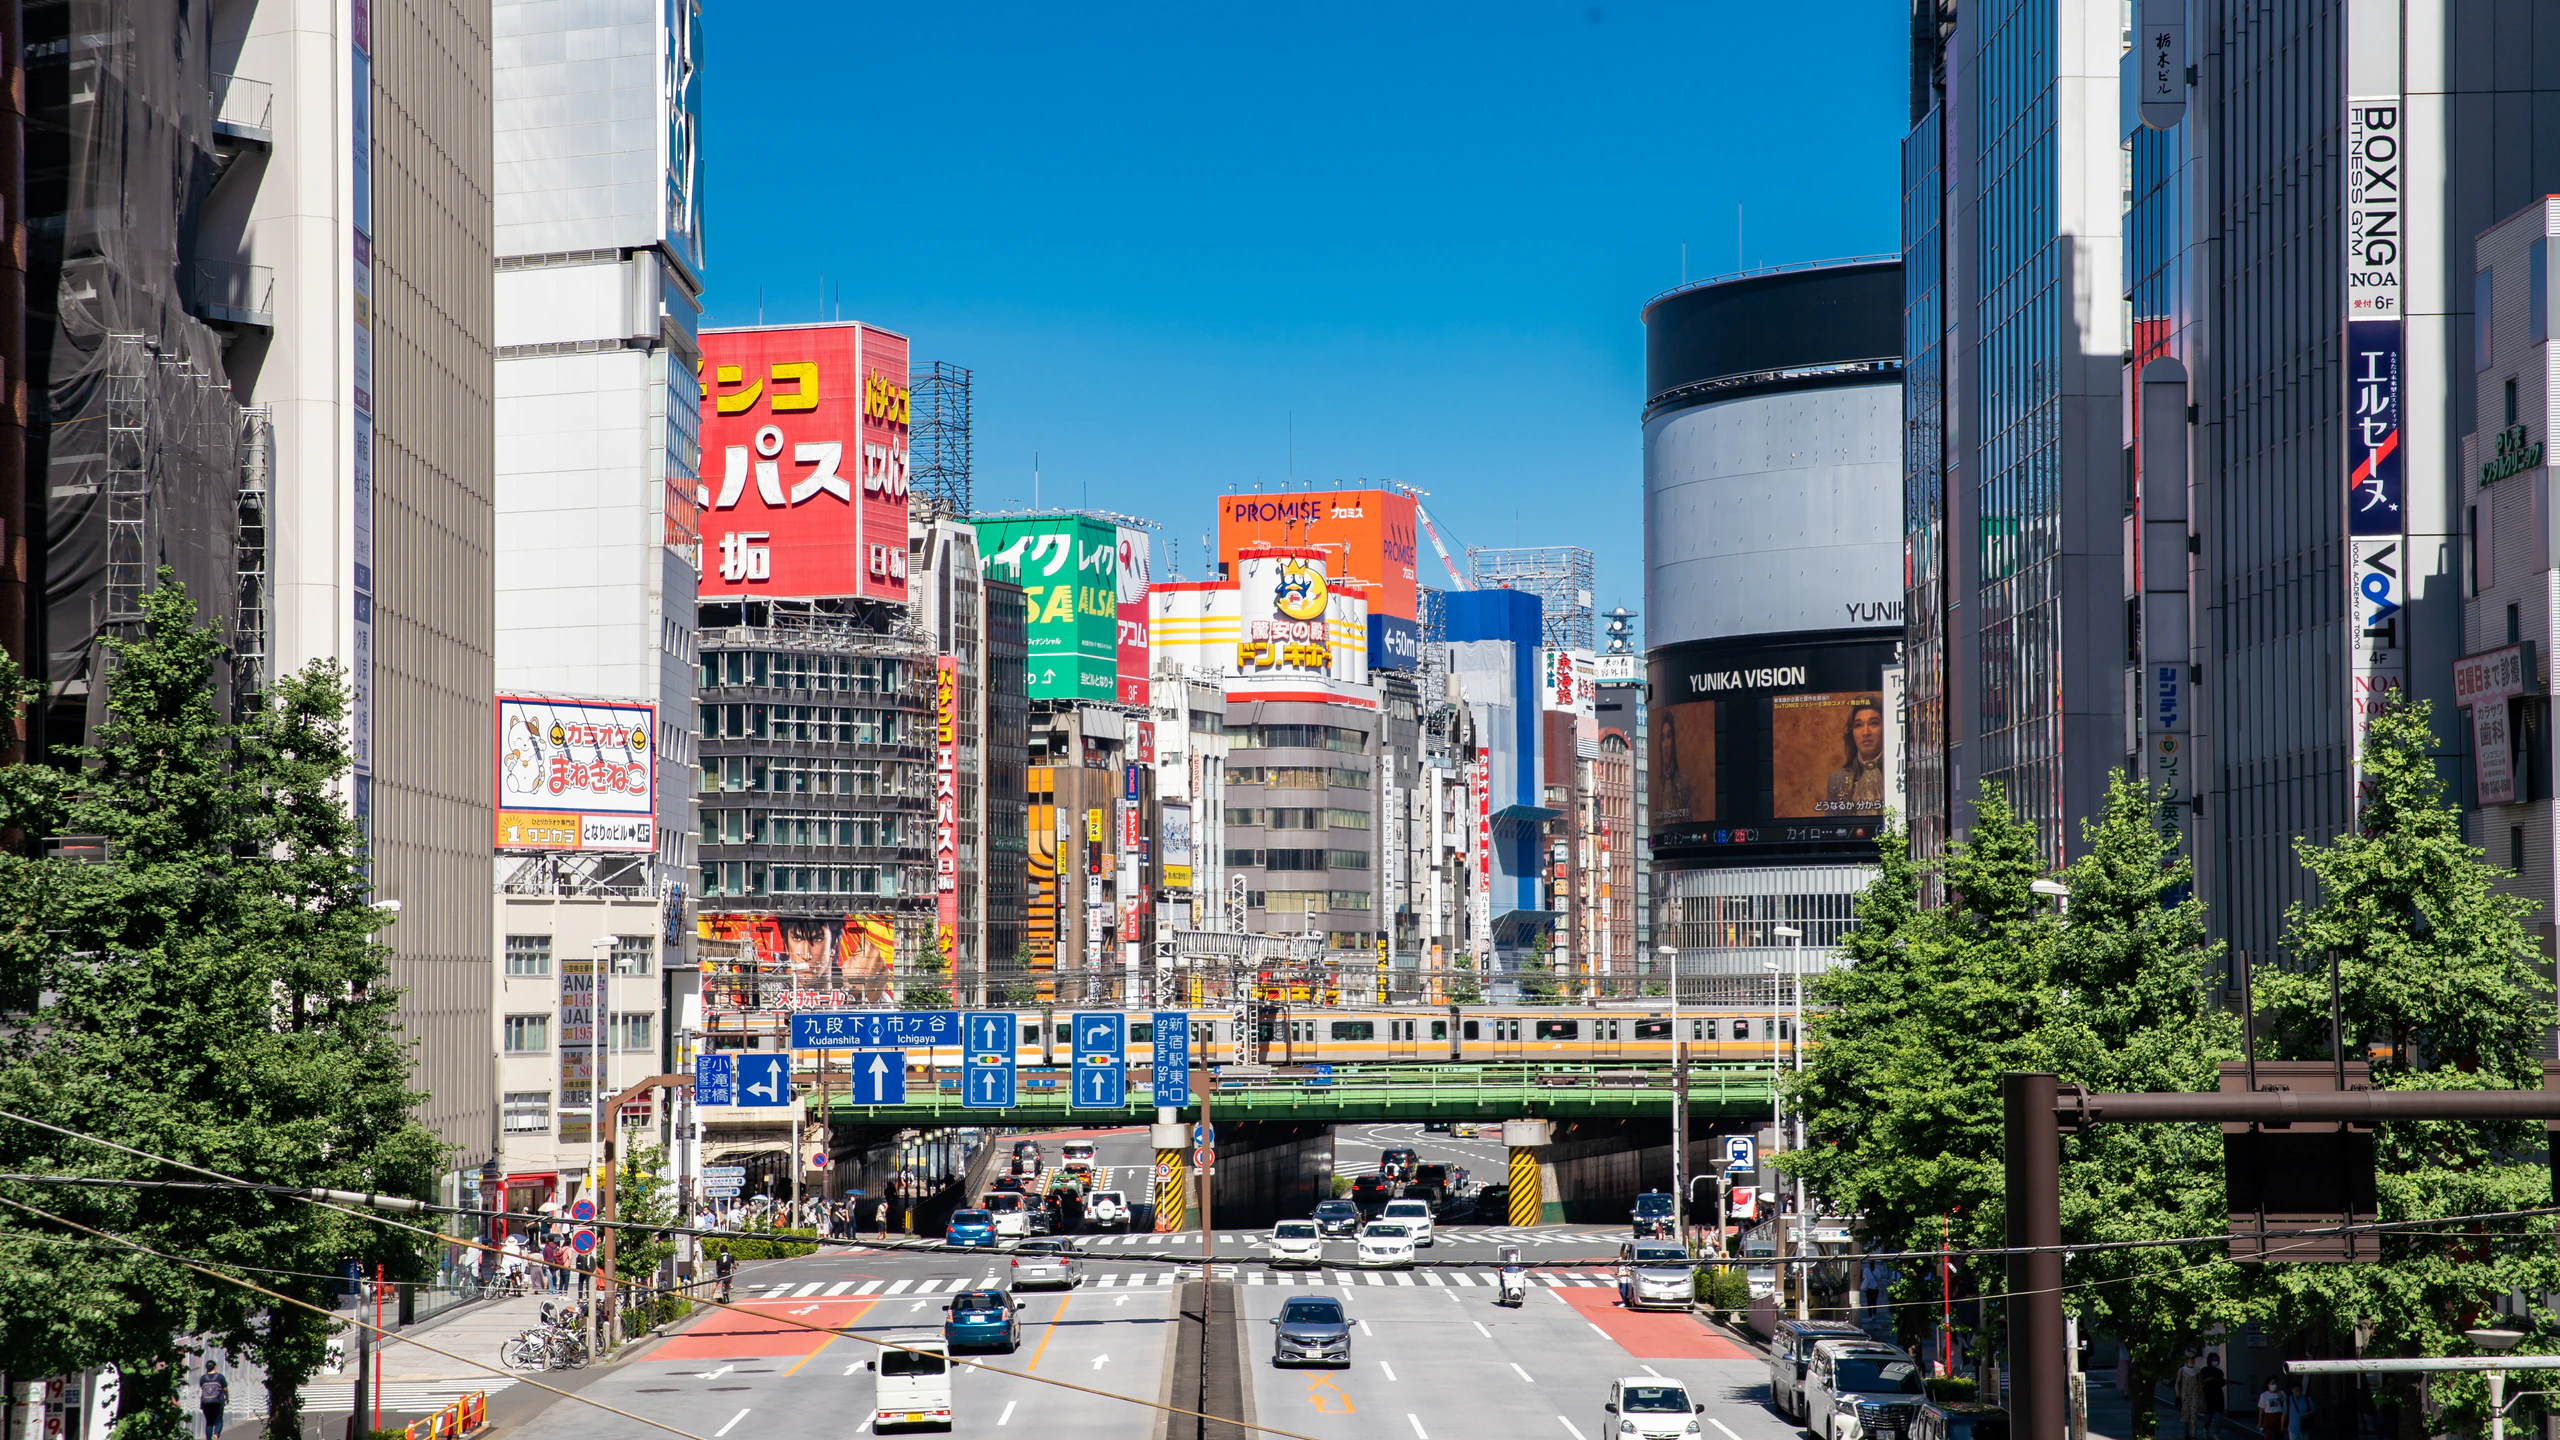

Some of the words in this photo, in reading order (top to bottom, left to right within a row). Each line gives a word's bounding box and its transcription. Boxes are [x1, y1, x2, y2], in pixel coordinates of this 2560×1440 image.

[2155, 33, 2172, 95] 栃木ビル
[2351, 108, 2363, 204] FITNESS
[2365, 107, 2397, 266] BOXING
[2351, 211, 2363, 255] GYM
[2350, 272, 2398, 287] NOA
[2354, 300, 2372, 308] 受付
[2375, 296, 2394, 309] 6F
[865, 367, 908, 425] パチンコ
[2356, 351, 2389, 512] エルセーヌ
[864, 434, 909, 497] エスパス
[1235, 501, 1321, 522] PROMISE
[1331, 507, 1364, 519] プロミス
[1079, 540, 1114, 576] レイク
[1384, 539, 1414, 567] PROMISE
[1078, 585, 1116, 620] ALSA
[2354, 611, 2360, 621] OF
[1118, 619, 1148, 649] アコム
[1395, 630, 1415, 658] 50m
[2370, 651, 2387, 664] 4F
[1690, 670, 1742, 693] YUNIKA
[1745, 666, 1806, 689] VISION
[2457, 654, 2520, 697] 日曜日まで診療
[938, 668, 953, 742] パチンコ
[1128, 685, 1139, 701] 3F
[2477, 704, 2503, 720] カラサワ
[567, 725, 630, 747] カラオケ
[2479, 720, 2505, 747] 歯科
[549, 754, 646, 794] まねきねこ
[1480, 755, 1488, 801] カラオケ
[938, 747, 954, 851] エスパス
[1814, 801, 1855, 811] どうなるか
[527, 828, 576, 843] ワンカラ
[532, 818, 575, 827] ひとりカラオケ専門店
[584, 824, 628, 842] となりのビル
[638, 825, 650, 842] 4F
[1480, 814, 1489, 859] パセラ
[777, 990, 847, 1008] メガホール
[563, 1009, 594, 1024] JAL
[804, 1016, 866, 1034] 九段下
[872, 1026, 880, 1035] 4
[808, 1036, 861, 1046] Kudanshita
[897, 1034, 936, 1046] Ichigaya
[1157, 1020, 1168, 1062] Shinjuku
[1169, 1017, 1184, 1101] 新宿駅東口
[712, 1057, 729, 1102] 小滝橋
[1157, 1065, 1168, 1100] Sta.-E.
